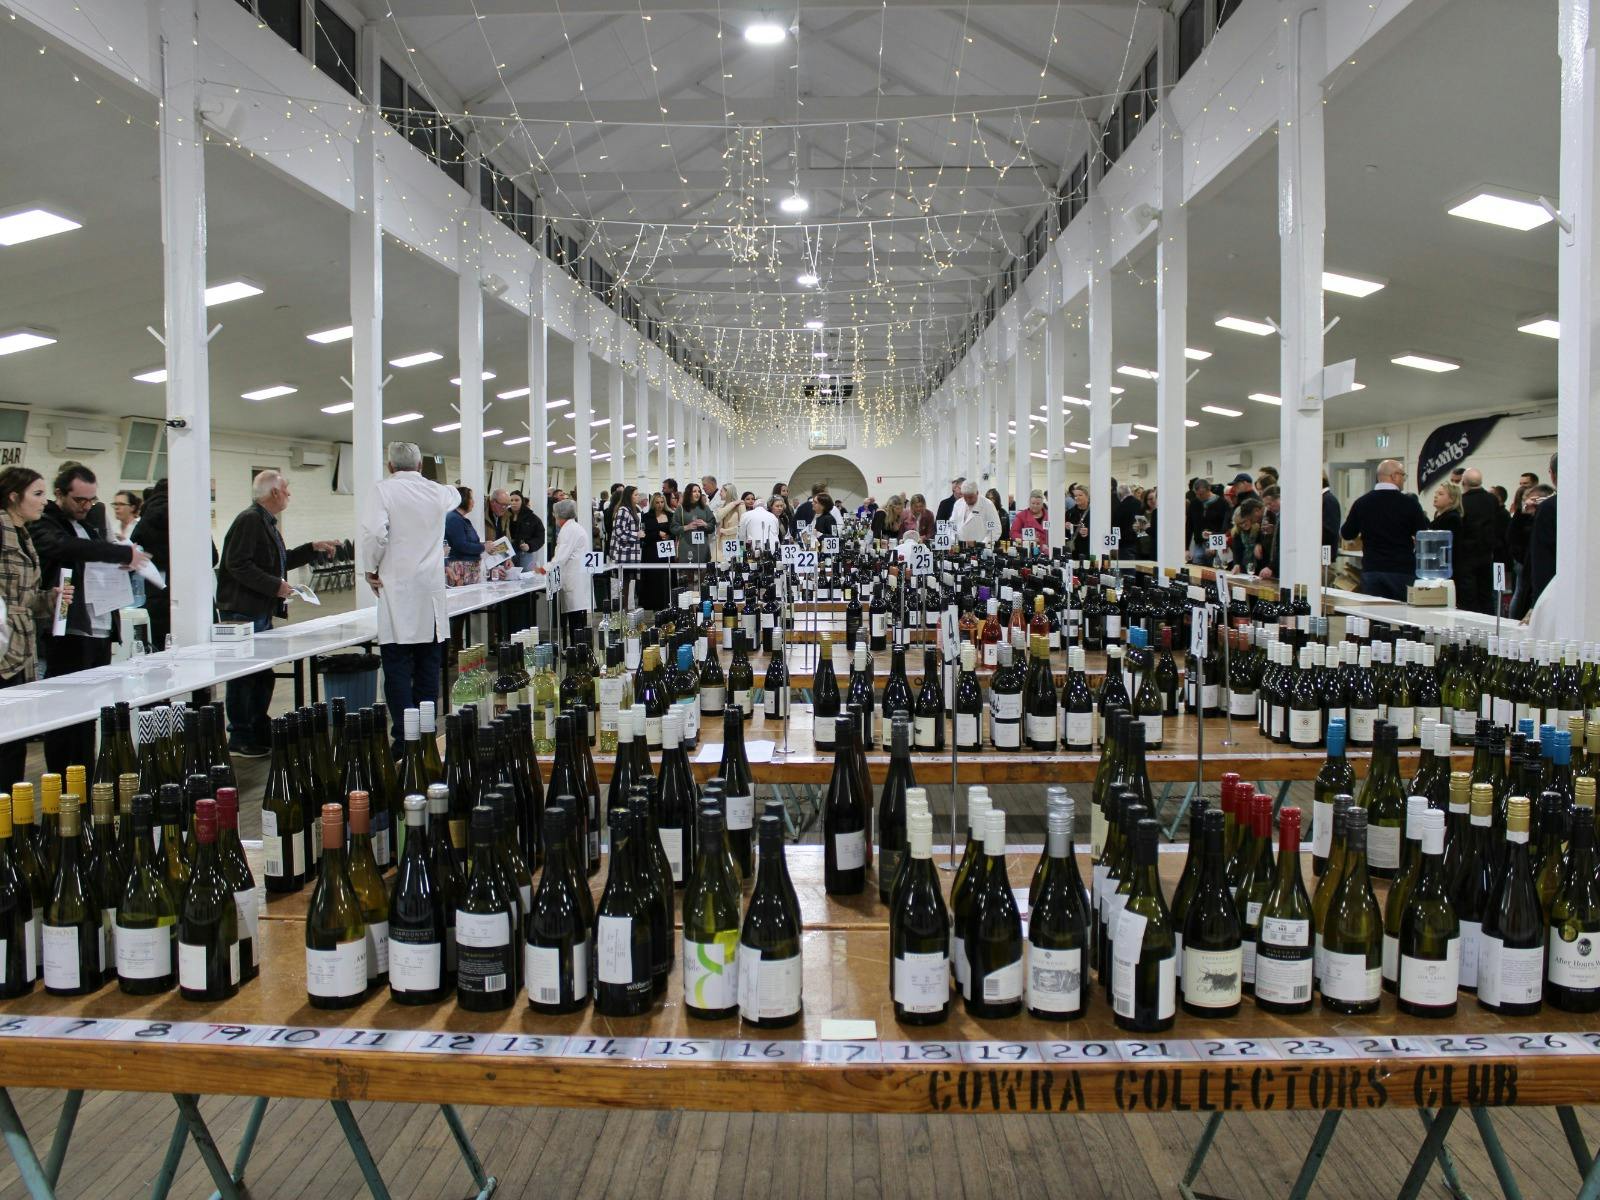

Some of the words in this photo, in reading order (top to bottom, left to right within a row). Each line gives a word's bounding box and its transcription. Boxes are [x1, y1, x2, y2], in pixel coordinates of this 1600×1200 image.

[2, 448, 21, 465] BAR
[694, 531, 703, 541] 41
[1024, 528, 1033, 537] 43
[659, 541, 672, 554] 34
[725, 540, 737, 552] 35
[826, 539, 837, 550] 36
[937, 535, 949, 547] 40
[1104, 535, 1117, 546] 39
[1212, 536, 1223, 546] 38
[585, 553, 599, 568] 21
[797, 553, 815, 568] 22
[916, 554, 930, 570] 25
[948, 613, 955, 644] 4
[1198, 611, 1203, 641] 3
[1573, 959, 1595, 968] Hours
[65, 1020, 96, 1034] 7
[135, 1023, 172, 1038] 8
[220, 1026, 251, 1041] 9
[265, 1028, 320, 1043] 10
[341, 1030, 387, 1046] 11
[420, 1034, 476, 1051] 12
[1508, 1034, 1568, 1049] 26
[497, 1036, 545, 1052] 13
[576, 1039, 627, 1056] 14
[654, 1040, 709, 1056] 15
[737, 1042, 786, 1058] 16
[1051, 1043, 1108, 1058] 20
[1128, 1042, 1172, 1057] 21
[1203, 1040, 1260, 1056] 22
[1281, 1040, 1335, 1055] 23
[1356, 1038, 1422, 1053] 24
[1438, 1037, 1489, 1052] 25
[900, 1044, 952, 1060] 18
[976, 1044, 1030, 1061] 19
[928, 1068, 1086, 1111] COWRA
[1114, 1066, 1389, 1111] COLLECTORS
[1413, 1063, 1519, 1108] CLUB
